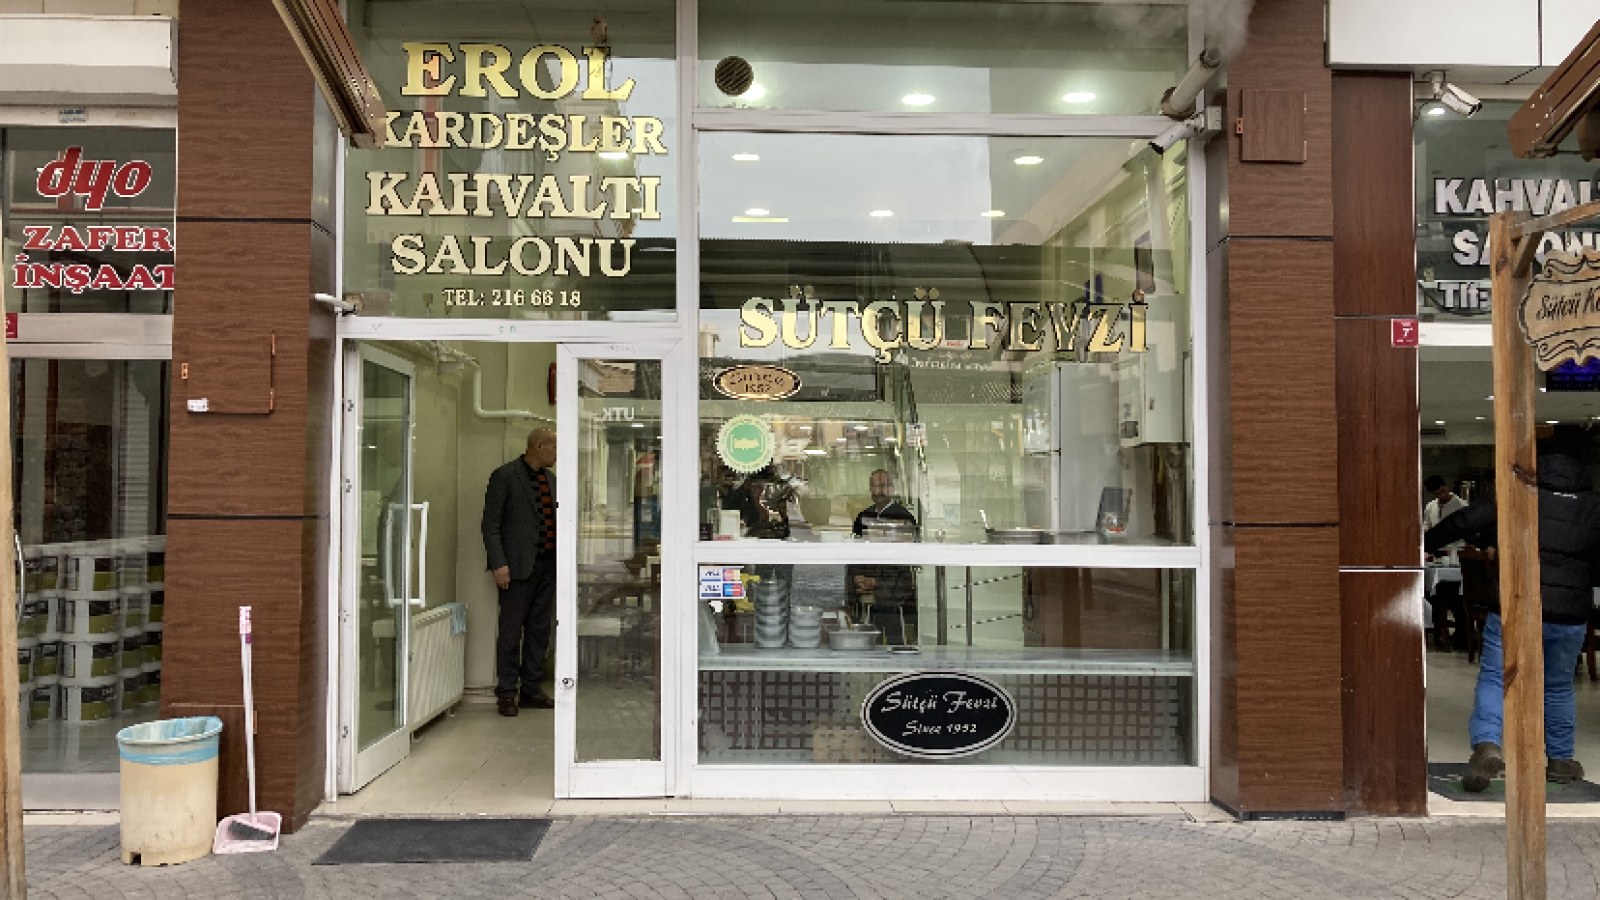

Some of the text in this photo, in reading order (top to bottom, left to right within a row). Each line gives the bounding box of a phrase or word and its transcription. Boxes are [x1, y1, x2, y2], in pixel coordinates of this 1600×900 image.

[400, 42, 636, 101] EROL
[36, 146, 152, 211] dyo
[365, 171, 661, 220] KAHVALTI
[23, 226, 174, 252] ZAFER
[390, 234, 636, 278] SALONU
[443, 289, 582, 308] TEL: 216 66 18
[740, 285, 945, 365] SÜTÇÜ
[881, 690, 939, 713] Sütçü
